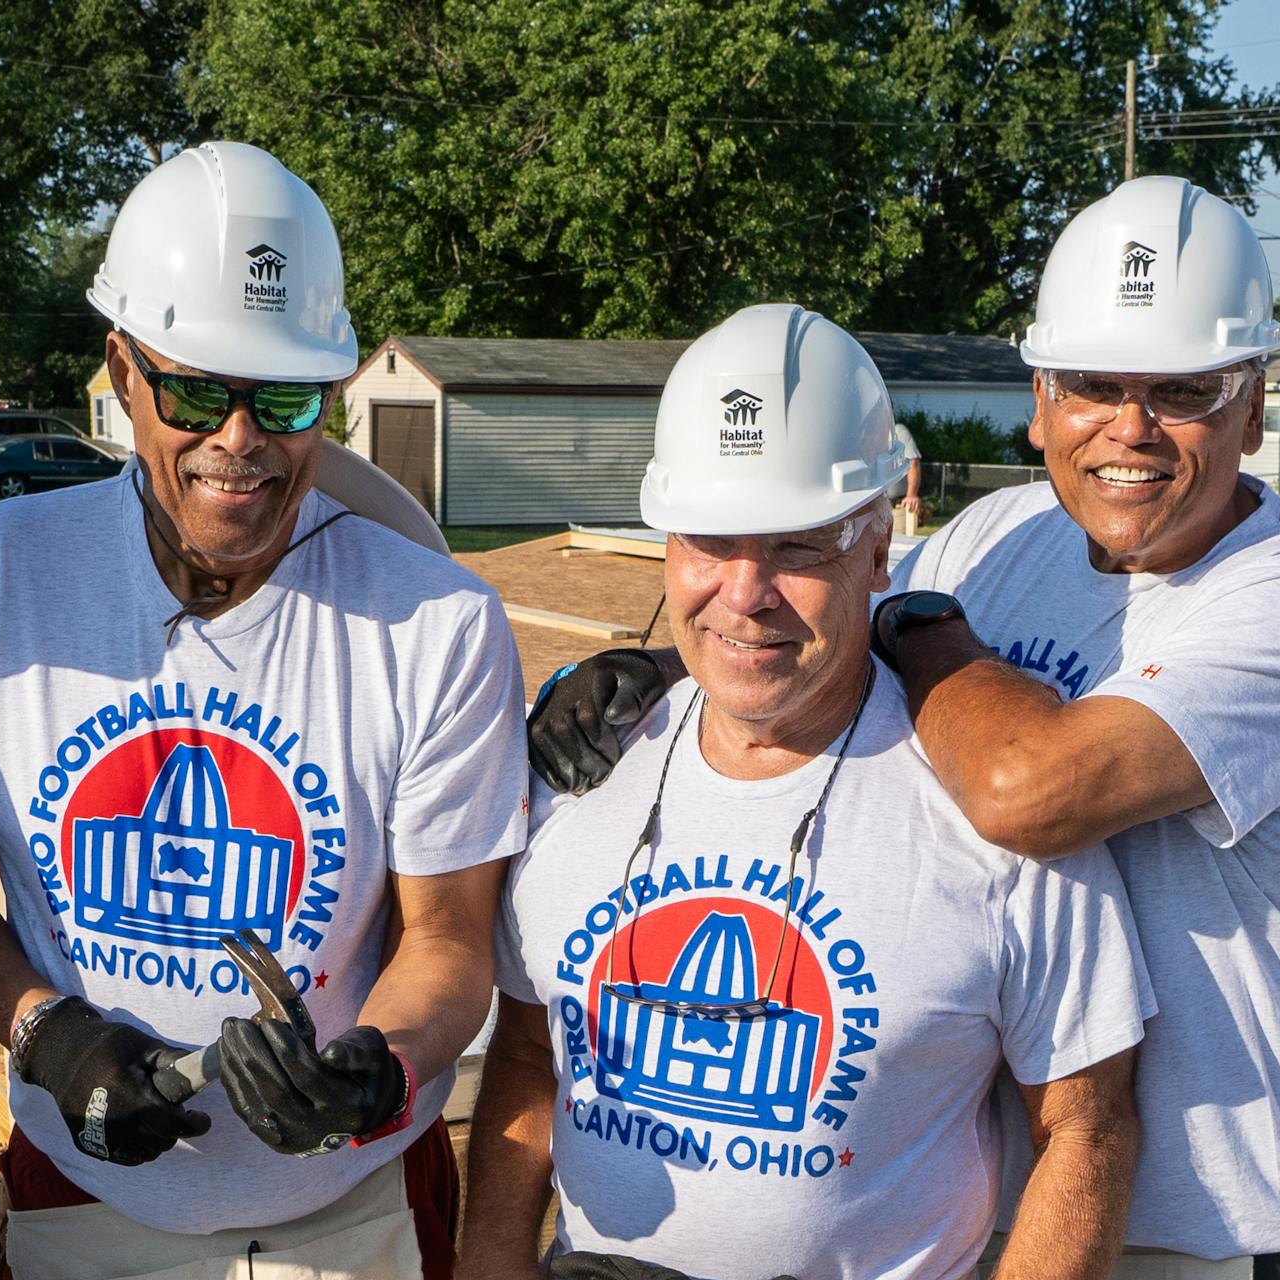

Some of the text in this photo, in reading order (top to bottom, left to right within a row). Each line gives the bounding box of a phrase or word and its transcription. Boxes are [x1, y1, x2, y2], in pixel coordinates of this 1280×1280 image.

[244, 282, 287, 298] Habitat
[1118, 281, 1155, 293] abitat
[256, 297, 286, 306] Humanity
[720, 429, 763, 441] Habitat
[732, 442, 763, 450] Humanity
[29, 682, 346, 952] PRO FOOTBALL HALL OF FAME
[55, 929, 312, 997] CANTON, OO
[556, 854, 879, 1131] PRO FOOTBALL HALL OF FAME
[573, 1098, 835, 1178] CANTON, OHIO
